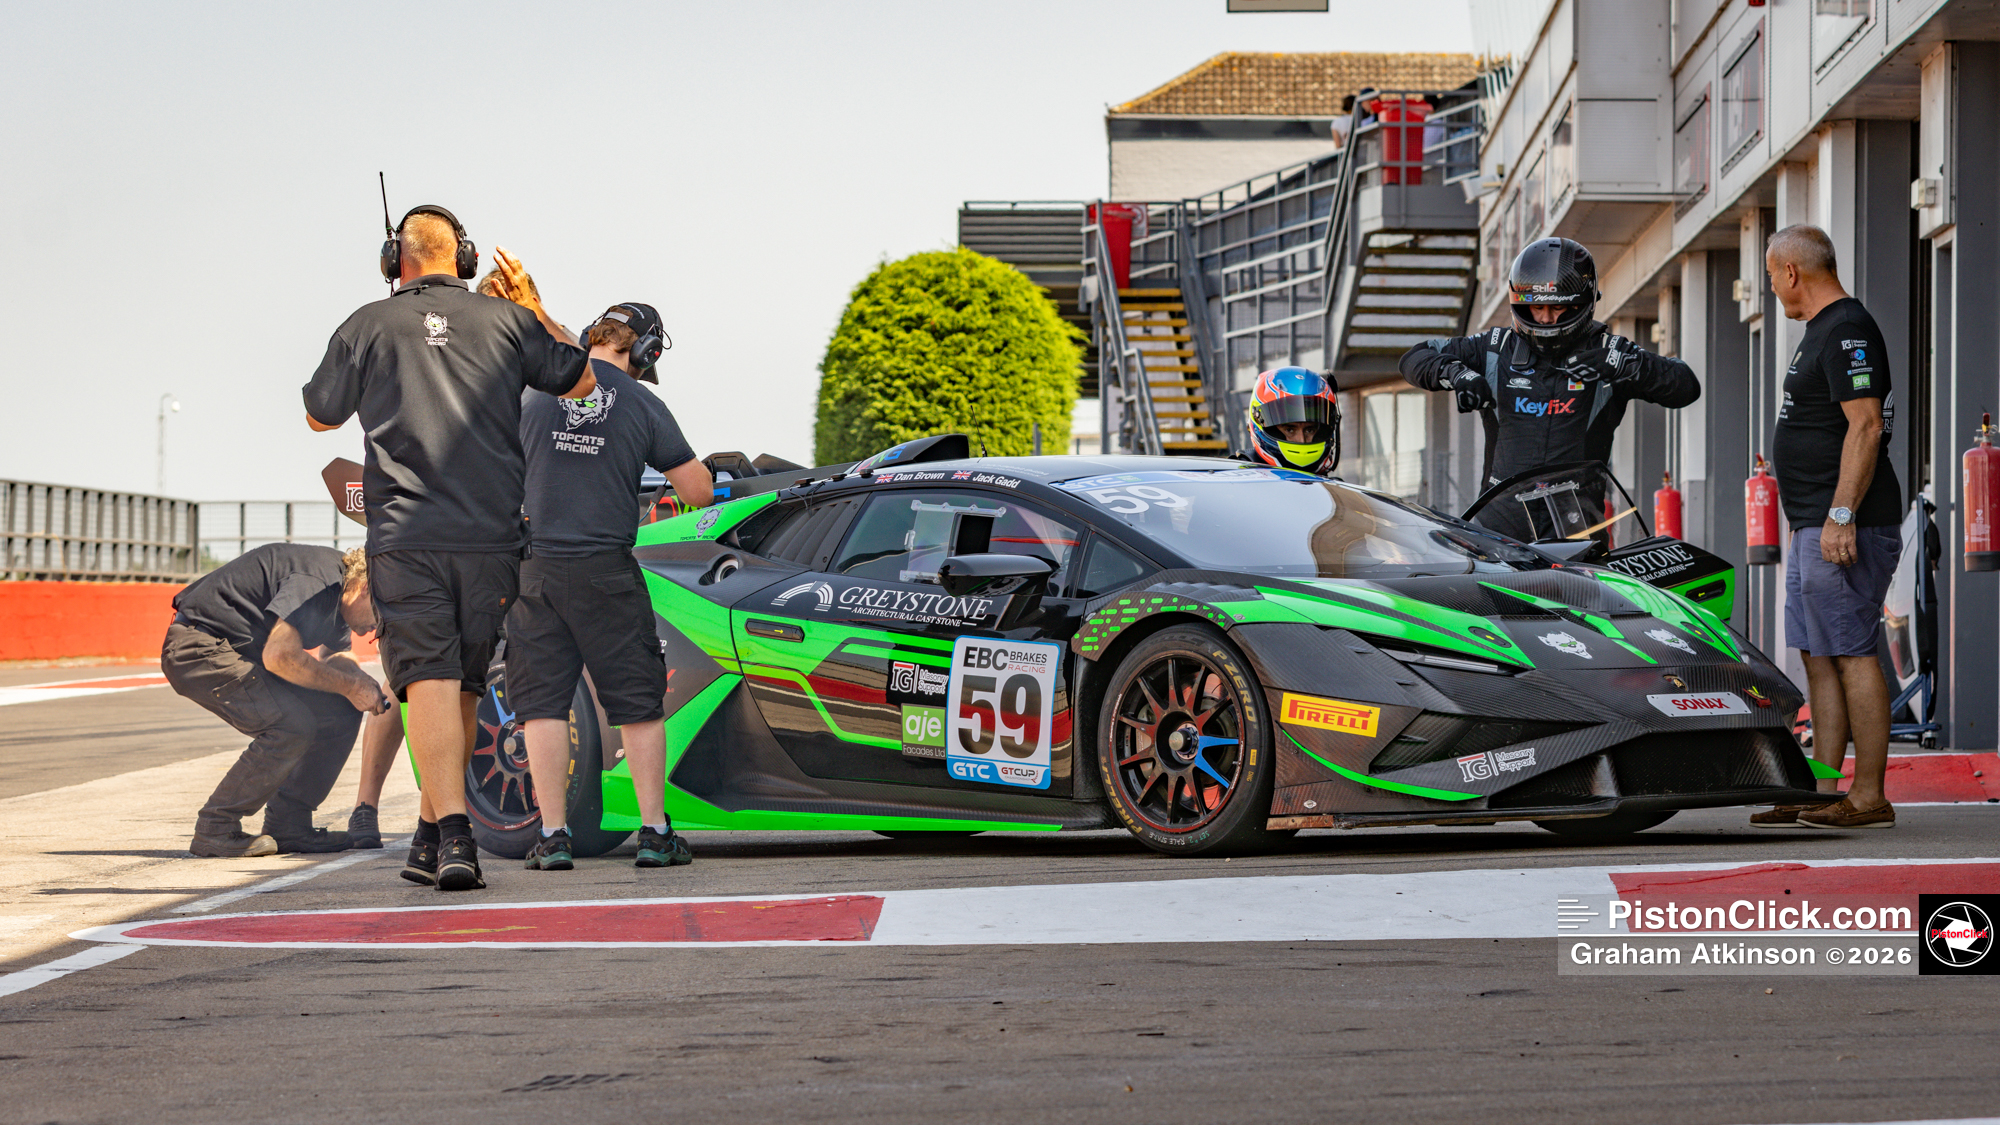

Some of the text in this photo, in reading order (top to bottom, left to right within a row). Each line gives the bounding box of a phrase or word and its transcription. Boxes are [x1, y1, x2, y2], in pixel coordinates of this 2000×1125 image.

[1532, 281, 1557, 292] Stilo
[1514, 294, 1580, 302] DWG Motorsport
[1854, 376, 1868, 386] aje
[1515, 397, 1576, 417] Keyfix
[552, 431, 605, 446] TOPCATS
[555, 441, 599, 455] RACING
[894, 471, 945, 481] Dan Brown
[972, 472, 1021, 488] Jack Gadd
[1086, 485, 1188, 514] 59
[1669, 564, 1687, 575] STONE
[839, 586, 993, 621] GREYSTONE
[851, 607, 962, 627] ARCHITECTURAL CAST STONE
[963, 646, 1009, 671] EBC
[1010, 651, 1047, 663] BRAKES
[1008, 664, 1046, 674] RACING
[890, 668, 913, 692] IG
[919, 669, 949, 685] Masonry
[918, 680, 946, 695] Support
[1672, 698, 1730, 710] SONAX
[958, 674, 1042, 759] 59
[1288, 699, 1371, 731] PIRELLI
[905, 711, 941, 741] aje
[903, 744, 946, 758] Facades Ltd
[1495, 748, 1535, 762] Masonry
[952, 762, 990, 779] GTC
[1459, 758, 1492, 782] IG
[1498, 757, 1536, 772] Support
[1101, 762, 1143, 834] PIRELLI
